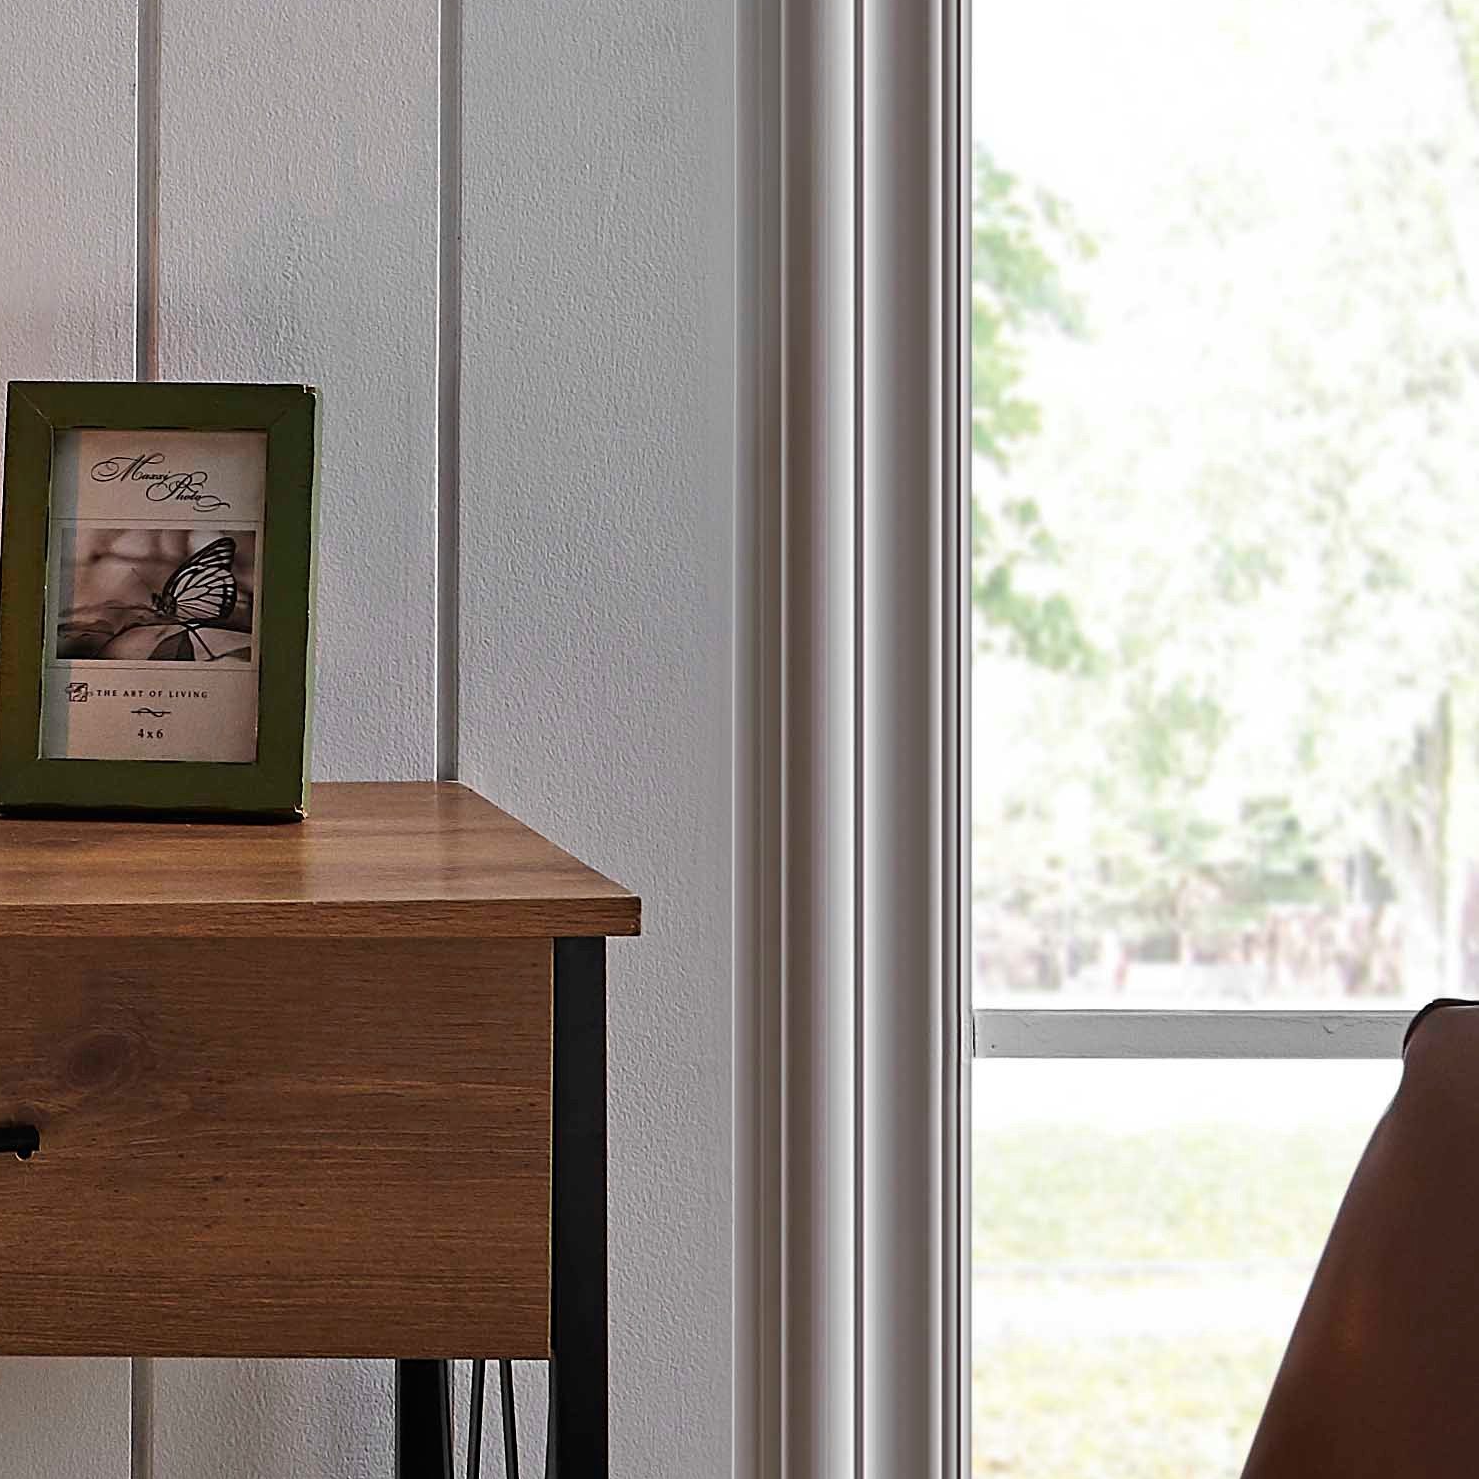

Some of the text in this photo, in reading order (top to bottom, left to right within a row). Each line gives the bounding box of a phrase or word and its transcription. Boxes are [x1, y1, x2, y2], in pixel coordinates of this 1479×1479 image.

[97, 689, 209, 699] THE ART OF LIVING
